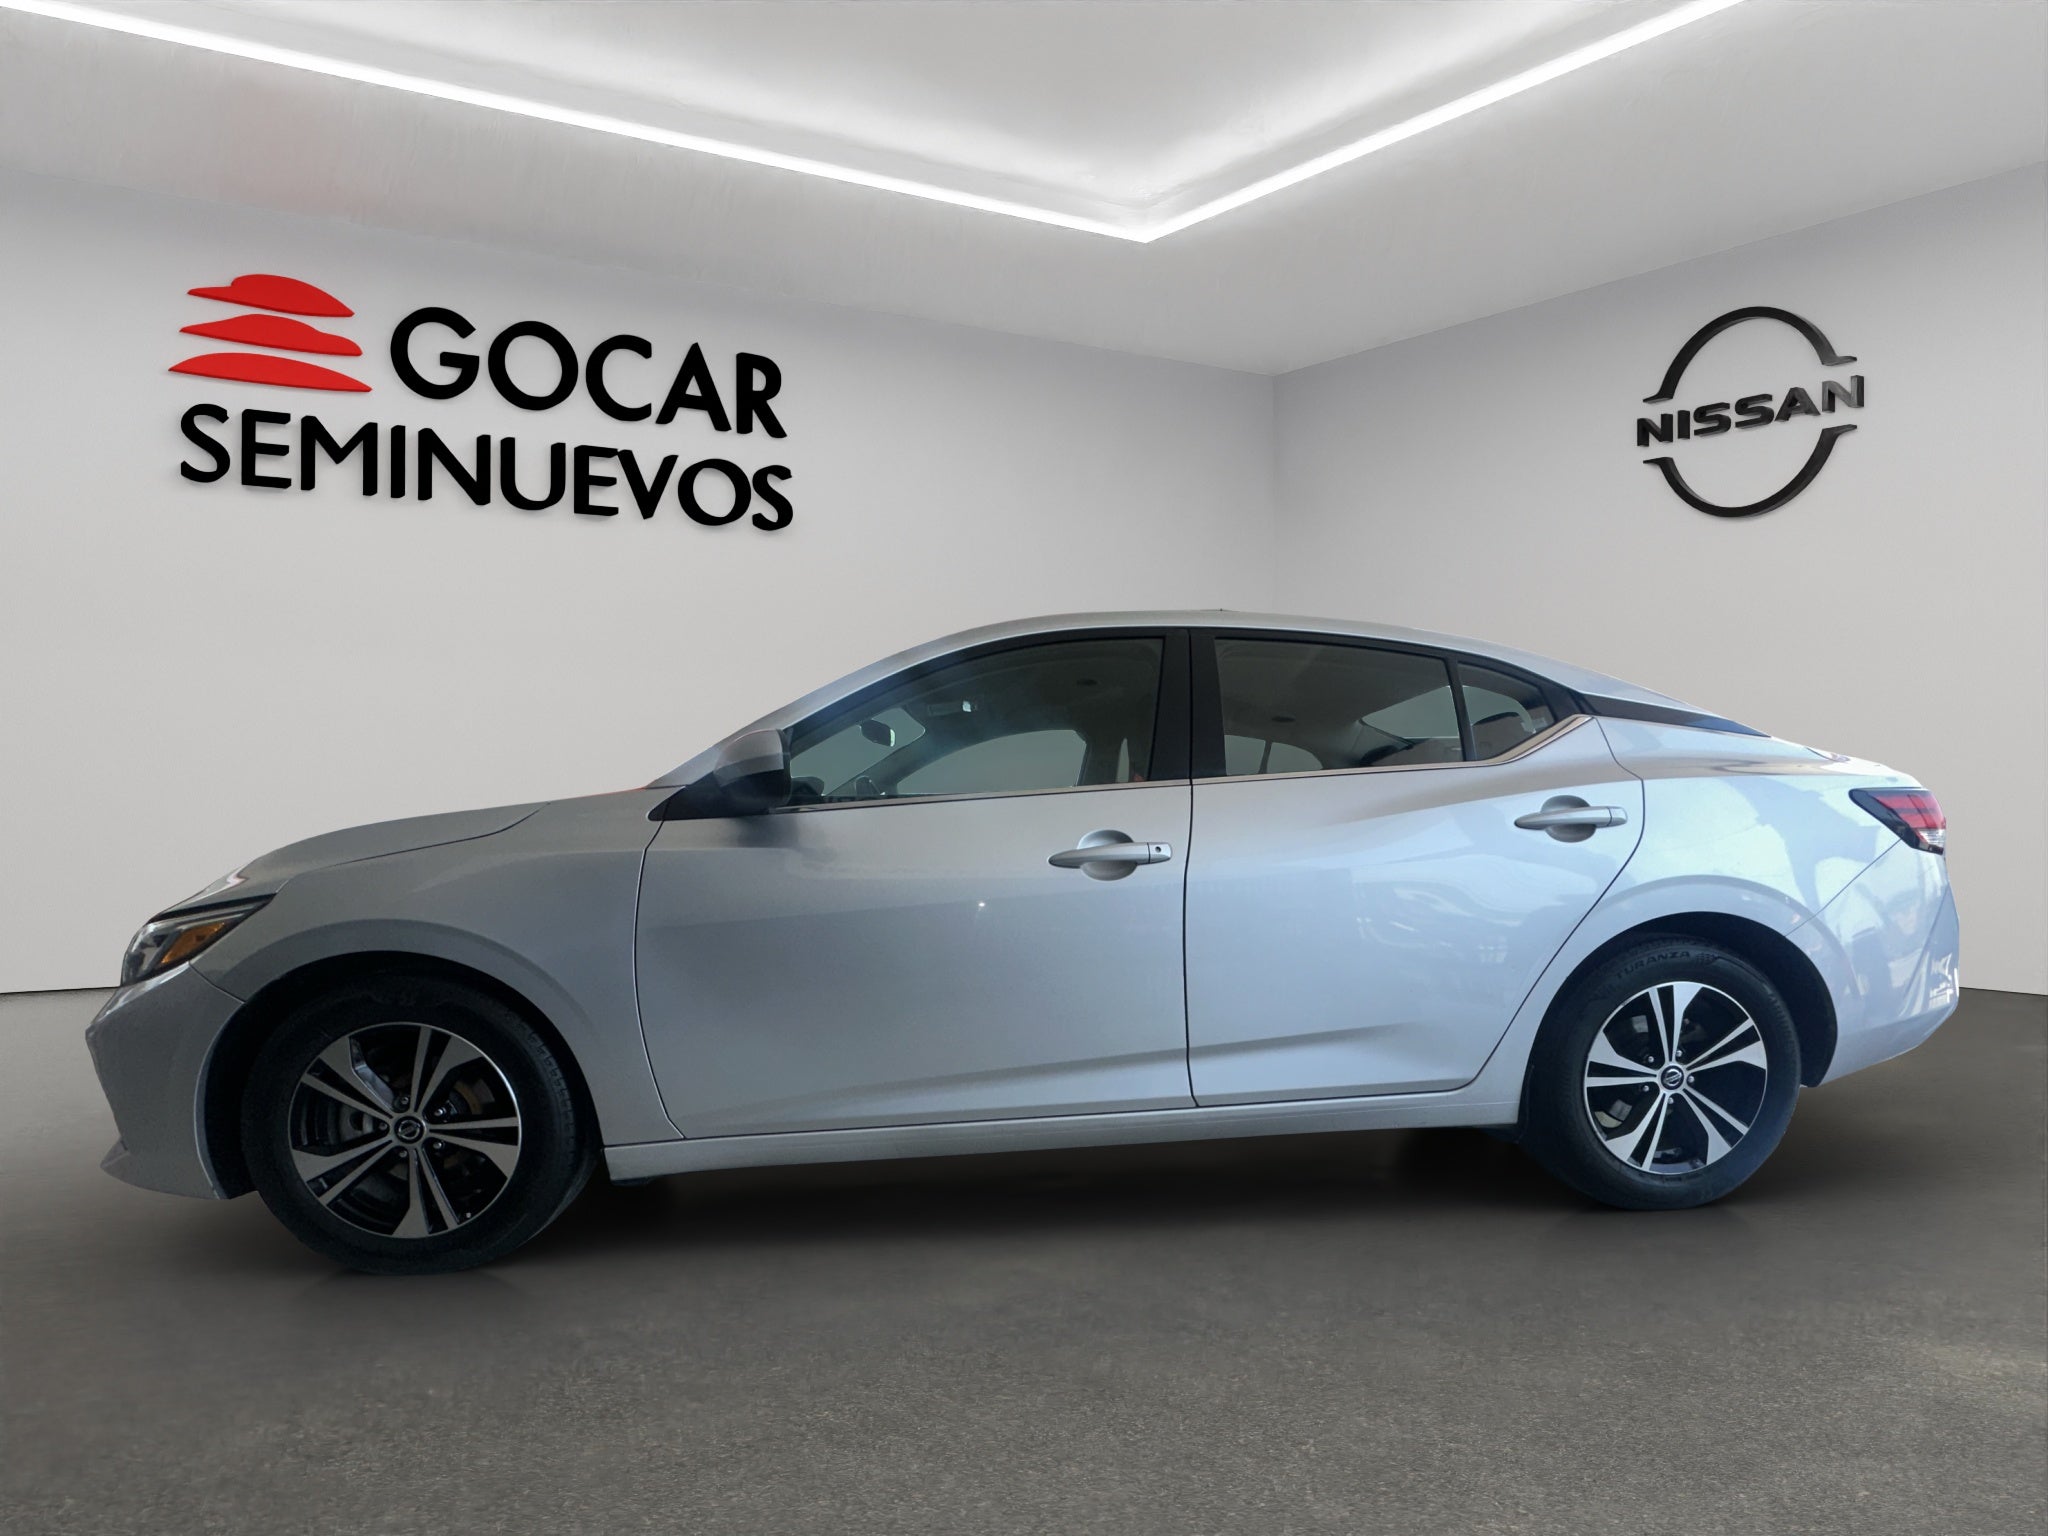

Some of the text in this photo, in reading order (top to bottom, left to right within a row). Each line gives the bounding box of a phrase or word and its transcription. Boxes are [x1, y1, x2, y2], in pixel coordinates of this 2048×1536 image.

[391, 307, 787, 438] GOCAR
[1637, 375, 1865, 447] NISSAN
[180, 404, 794, 531] SEMINUEVOS
[1616, 950, 1691, 980] TURANZA
